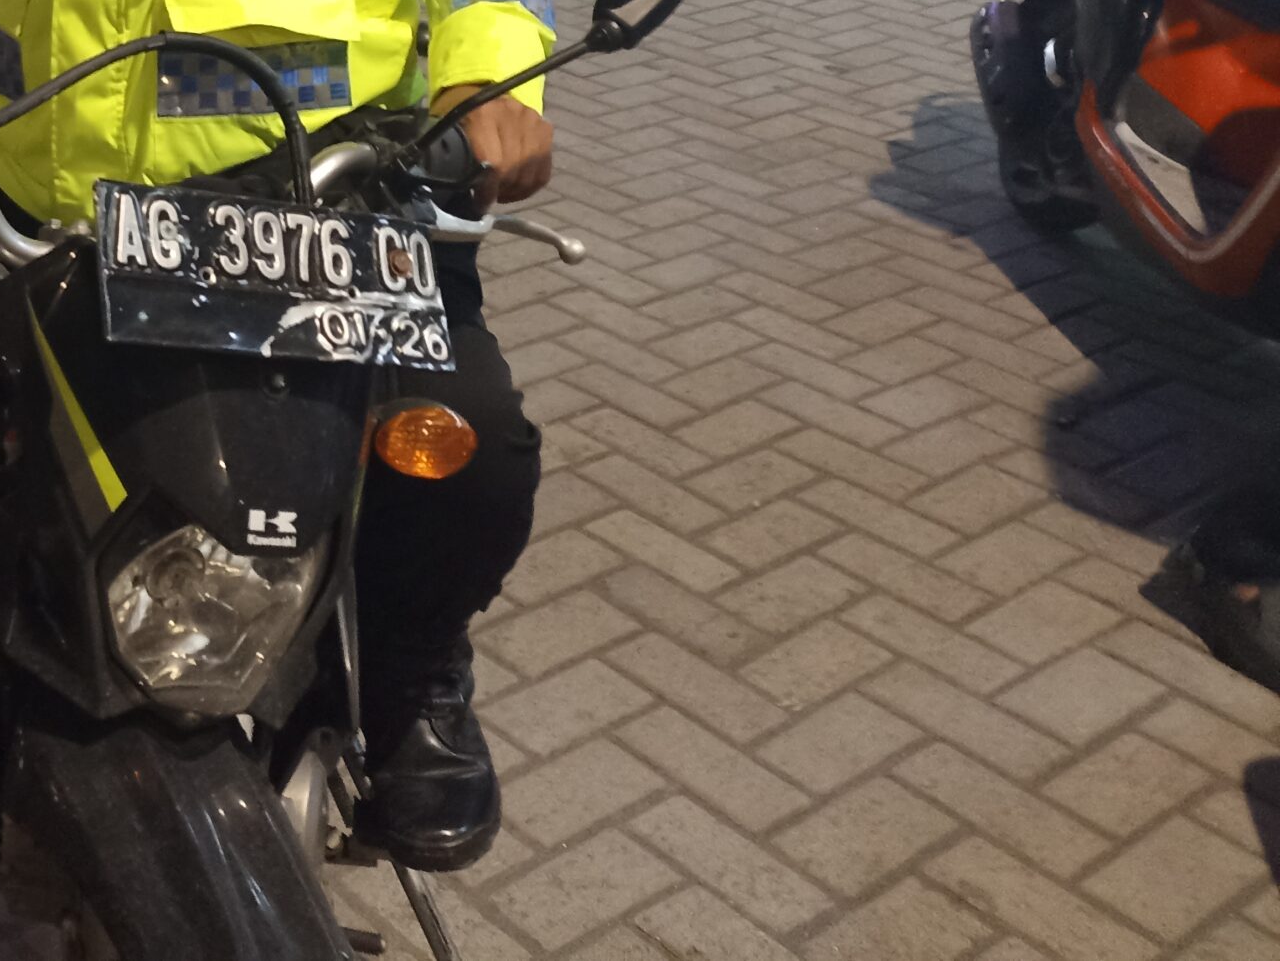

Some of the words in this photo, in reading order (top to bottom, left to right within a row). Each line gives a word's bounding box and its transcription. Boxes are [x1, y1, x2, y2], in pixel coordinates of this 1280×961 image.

[116, 192, 184, 271] AG
[214, 203, 354, 288] 3976
[377, 225, 437, 298] CO
